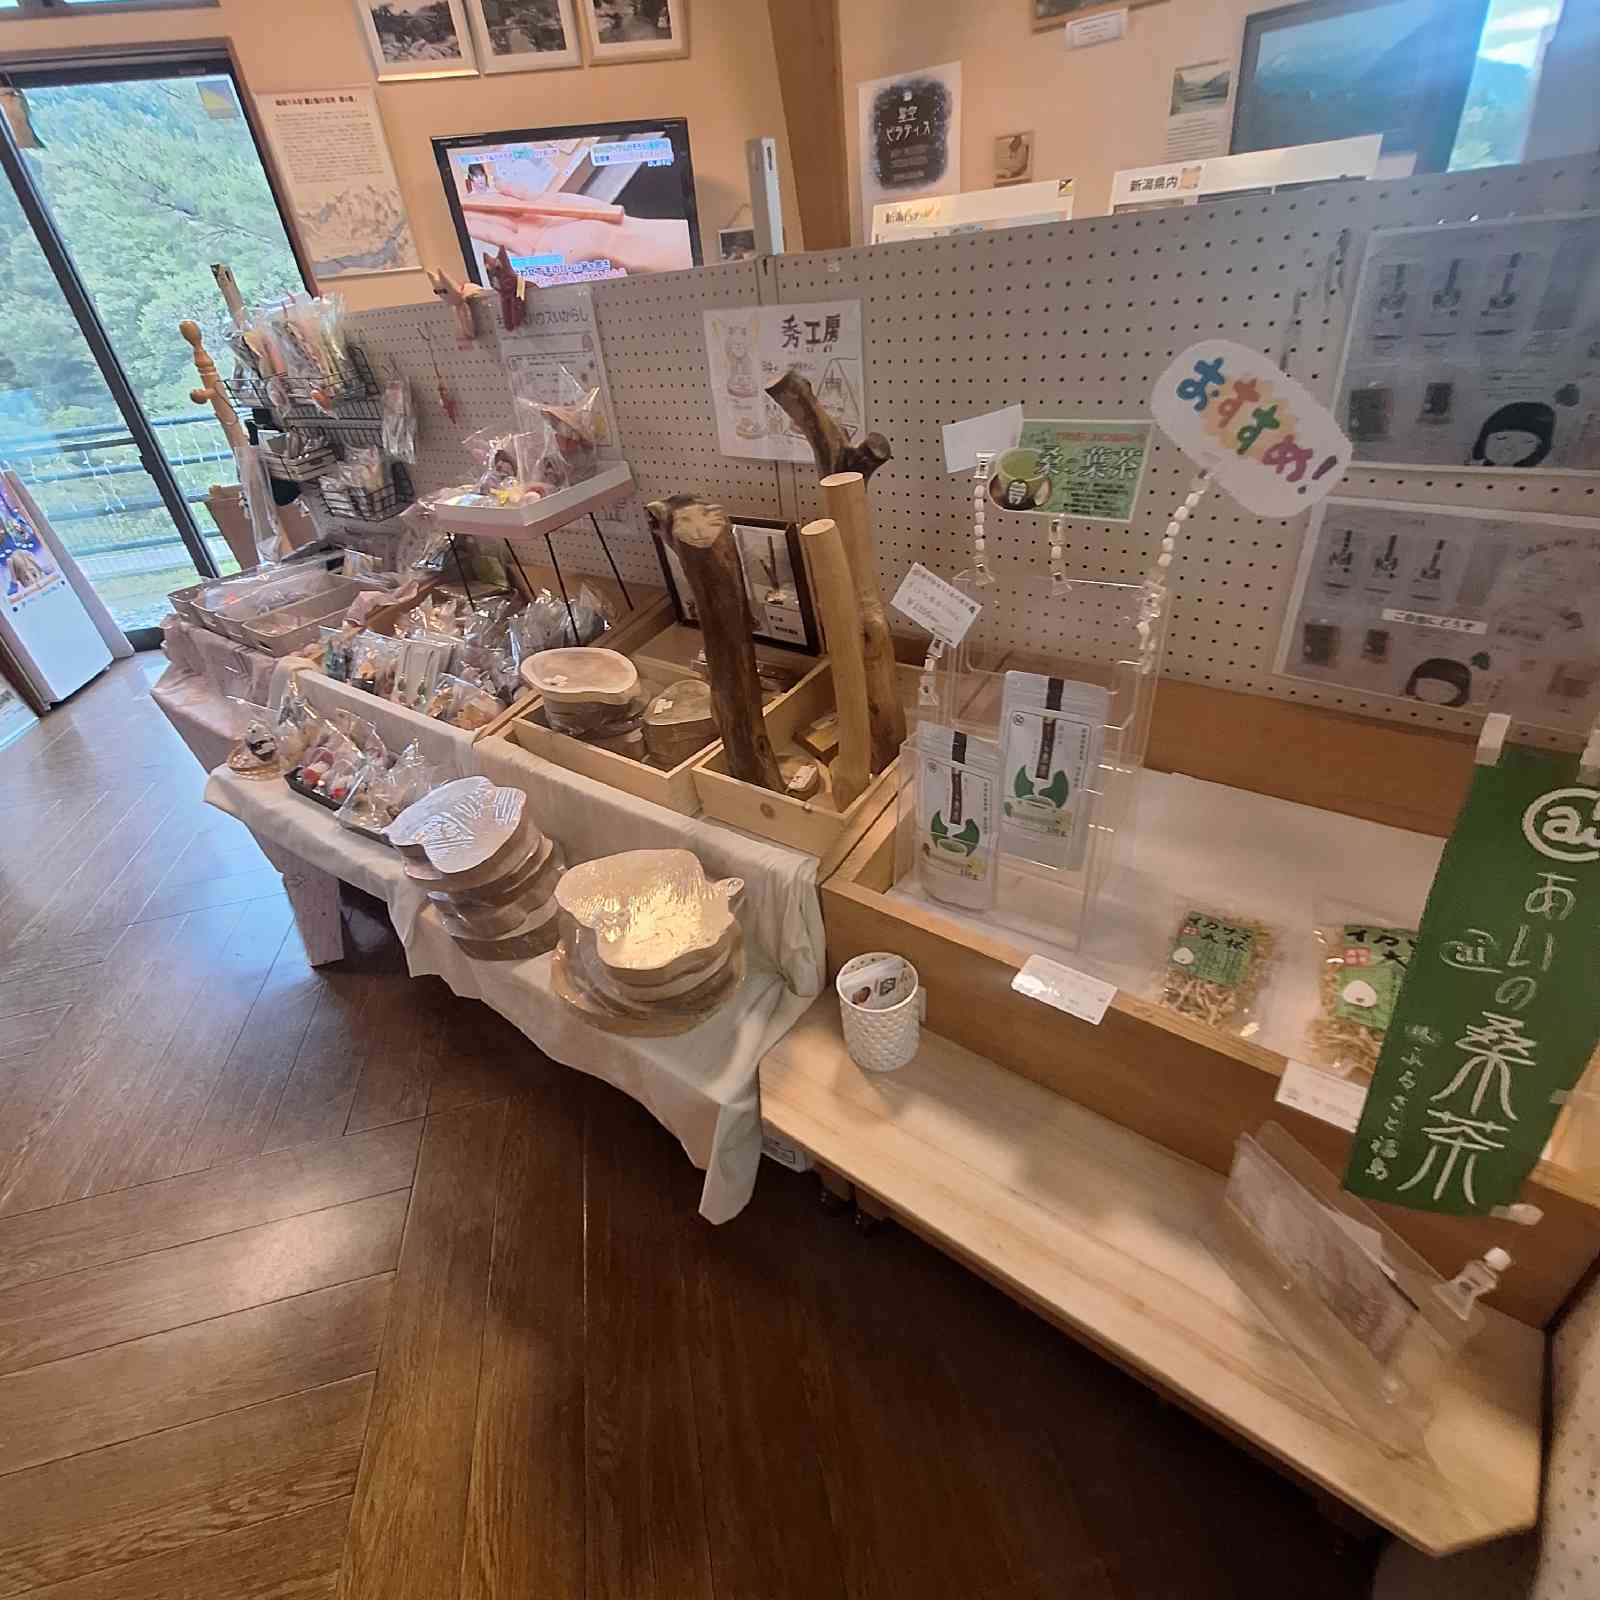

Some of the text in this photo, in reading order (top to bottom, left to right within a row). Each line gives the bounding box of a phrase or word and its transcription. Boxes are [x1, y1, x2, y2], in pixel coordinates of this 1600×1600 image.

[1129, 176, 1179, 192] 新潟県内
[781, 313, 841, 349] 秀工房
